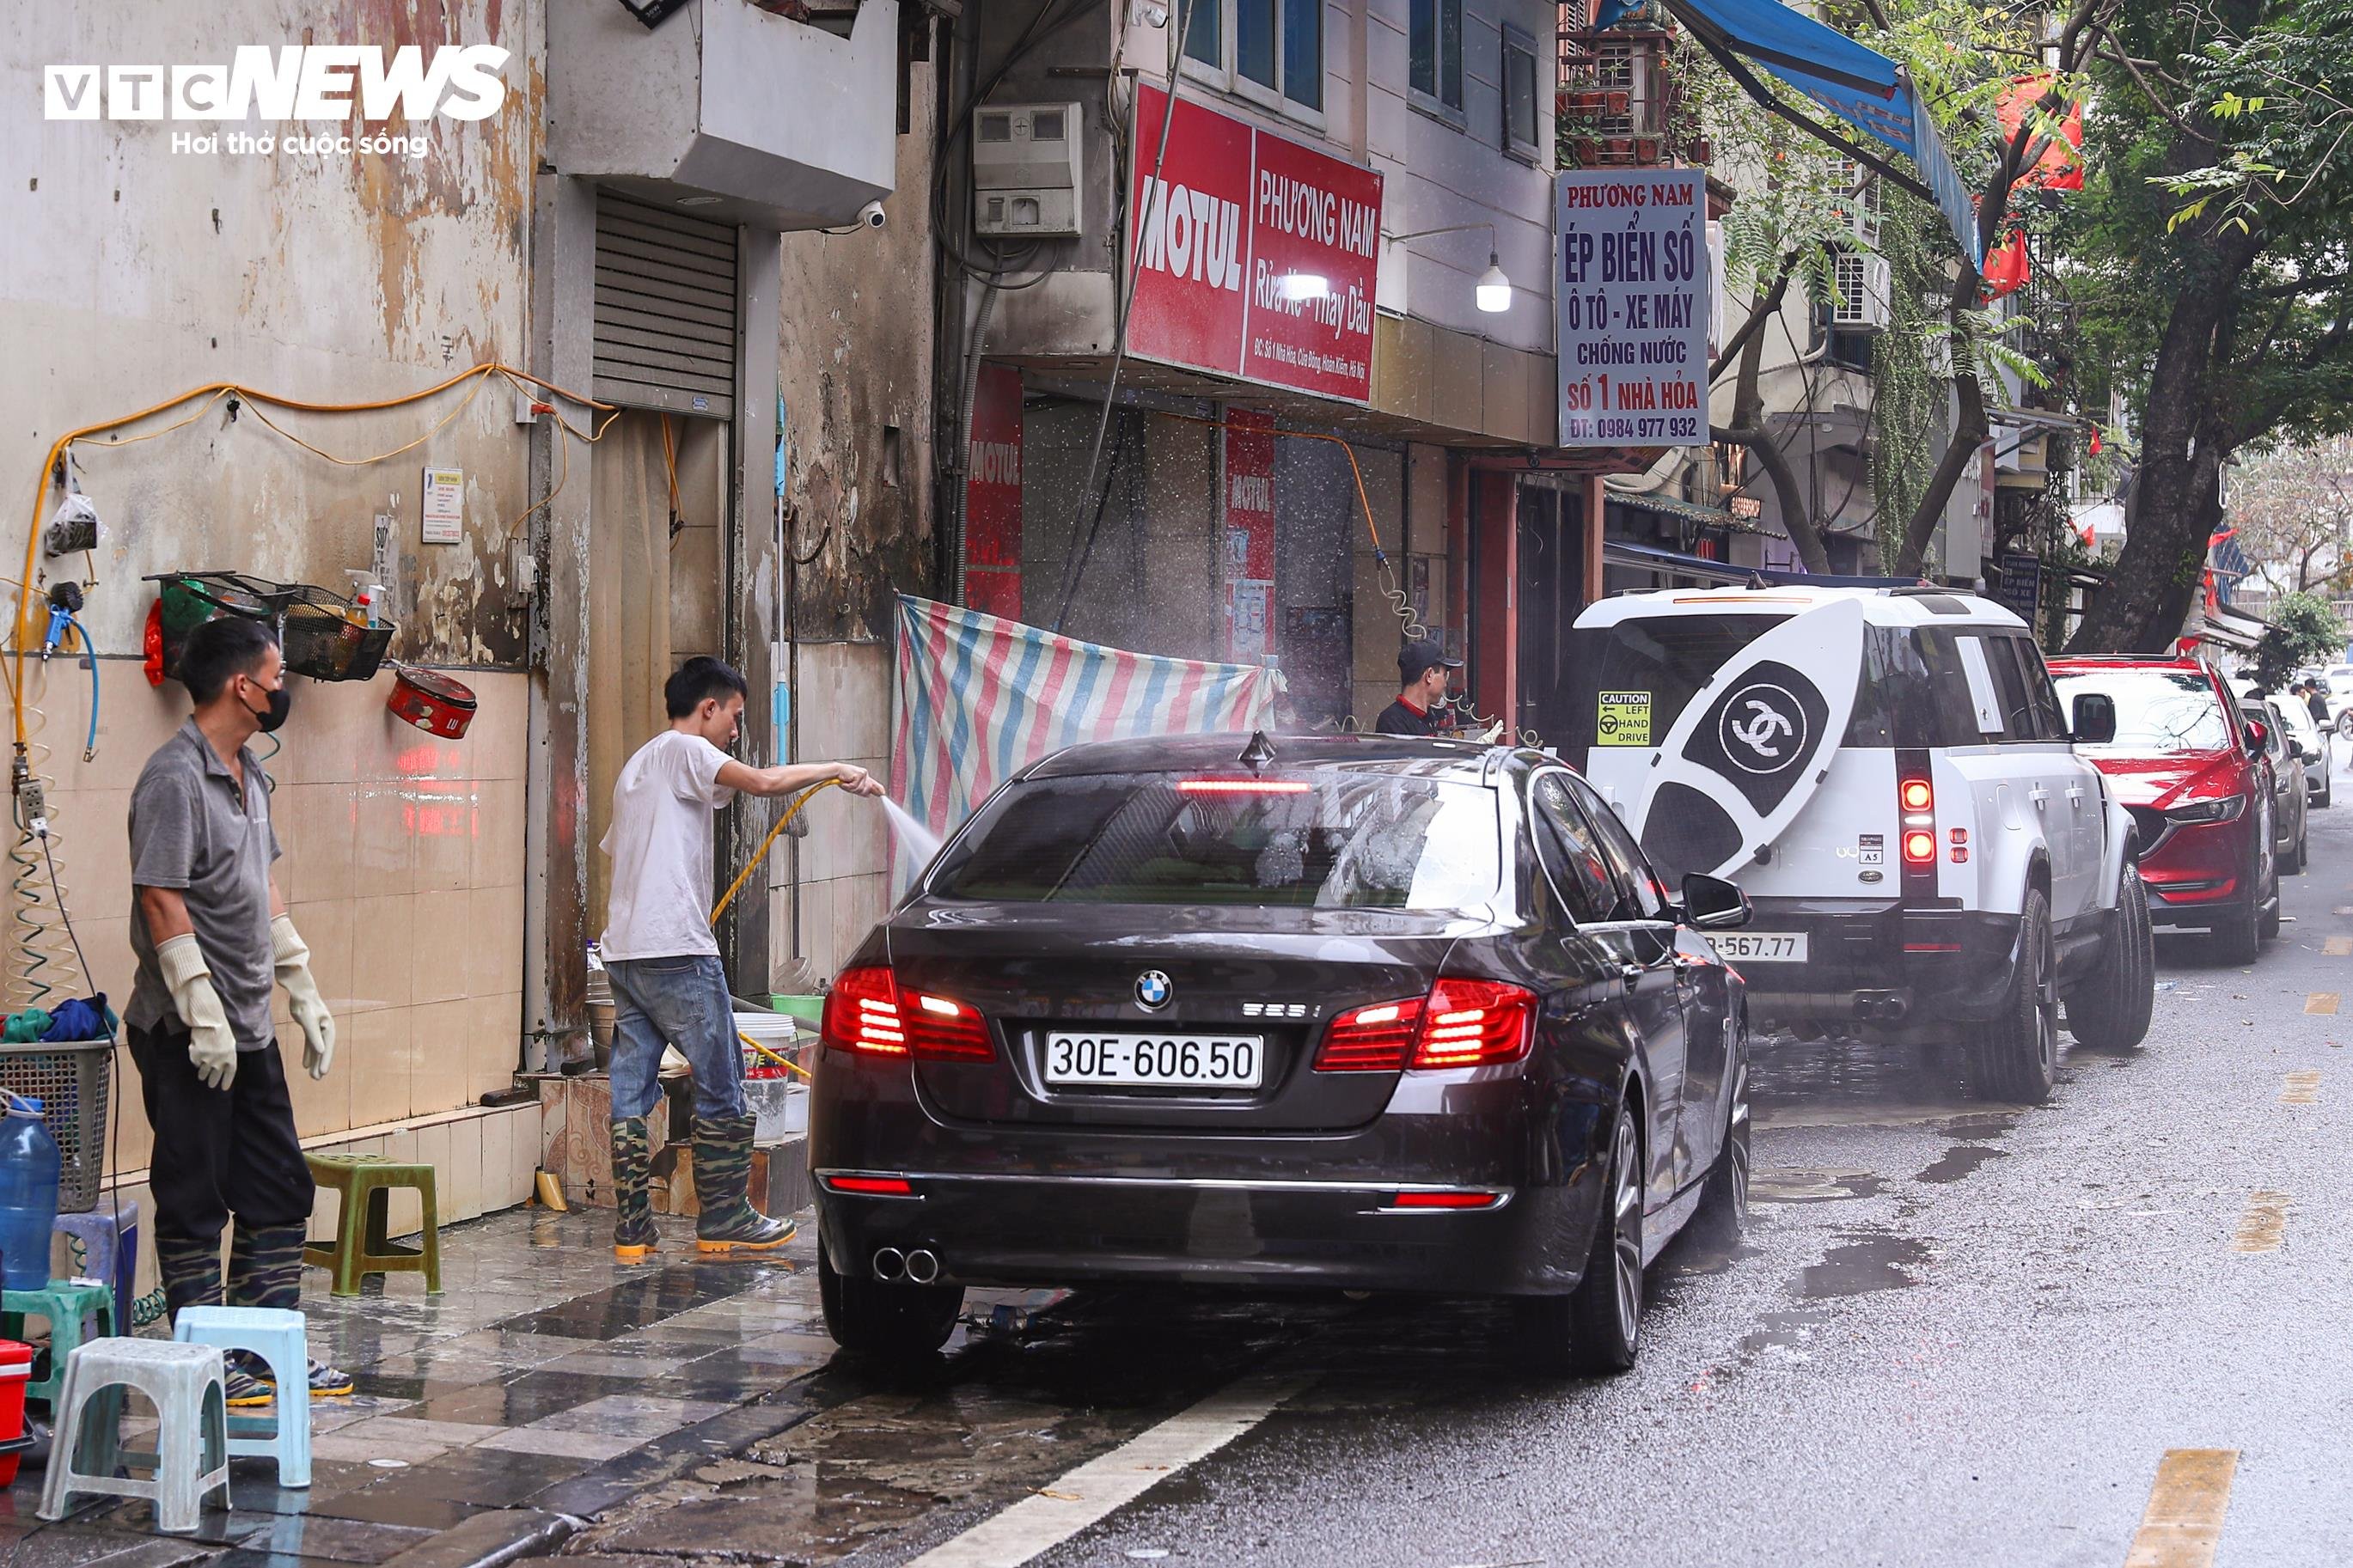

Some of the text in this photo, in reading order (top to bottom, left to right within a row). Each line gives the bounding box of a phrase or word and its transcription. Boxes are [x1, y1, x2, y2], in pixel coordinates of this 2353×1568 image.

[1259, 169, 1375, 259] PHƯƠNG NAM
[1568, 183, 1693, 208] PHƯƠNG NAM
[1134, 175, 1241, 291] MOTUL
[1565, 210, 1695, 283] ÉP BIỂN SỐ
[1347, 277, 1371, 335] Dầu
[1568, 288, 1580, 330] Ô
[1586, 288, 1608, 330] TÔ
[1626, 295, 1648, 329] XE
[1654, 286, 1693, 329] MÁY
[1577, 334, 1686, 364] CHỐNG NƯỚC
[1568, 369, 1698, 411] SỐ 1 NHÀ HỎA
[1570, 417, 1696, 438] ĐT: 0984 977 932
[969, 440, 1020, 485] MOTUL
[1232, 474, 1270, 512] MOTUL
[1601, 694, 1647, 704] CAUTION
[1626, 705, 1649, 714] LEFT
[1618, 733, 1648, 741] DRIVE
[1054, 1038, 1253, 1079] 30E-606.50
